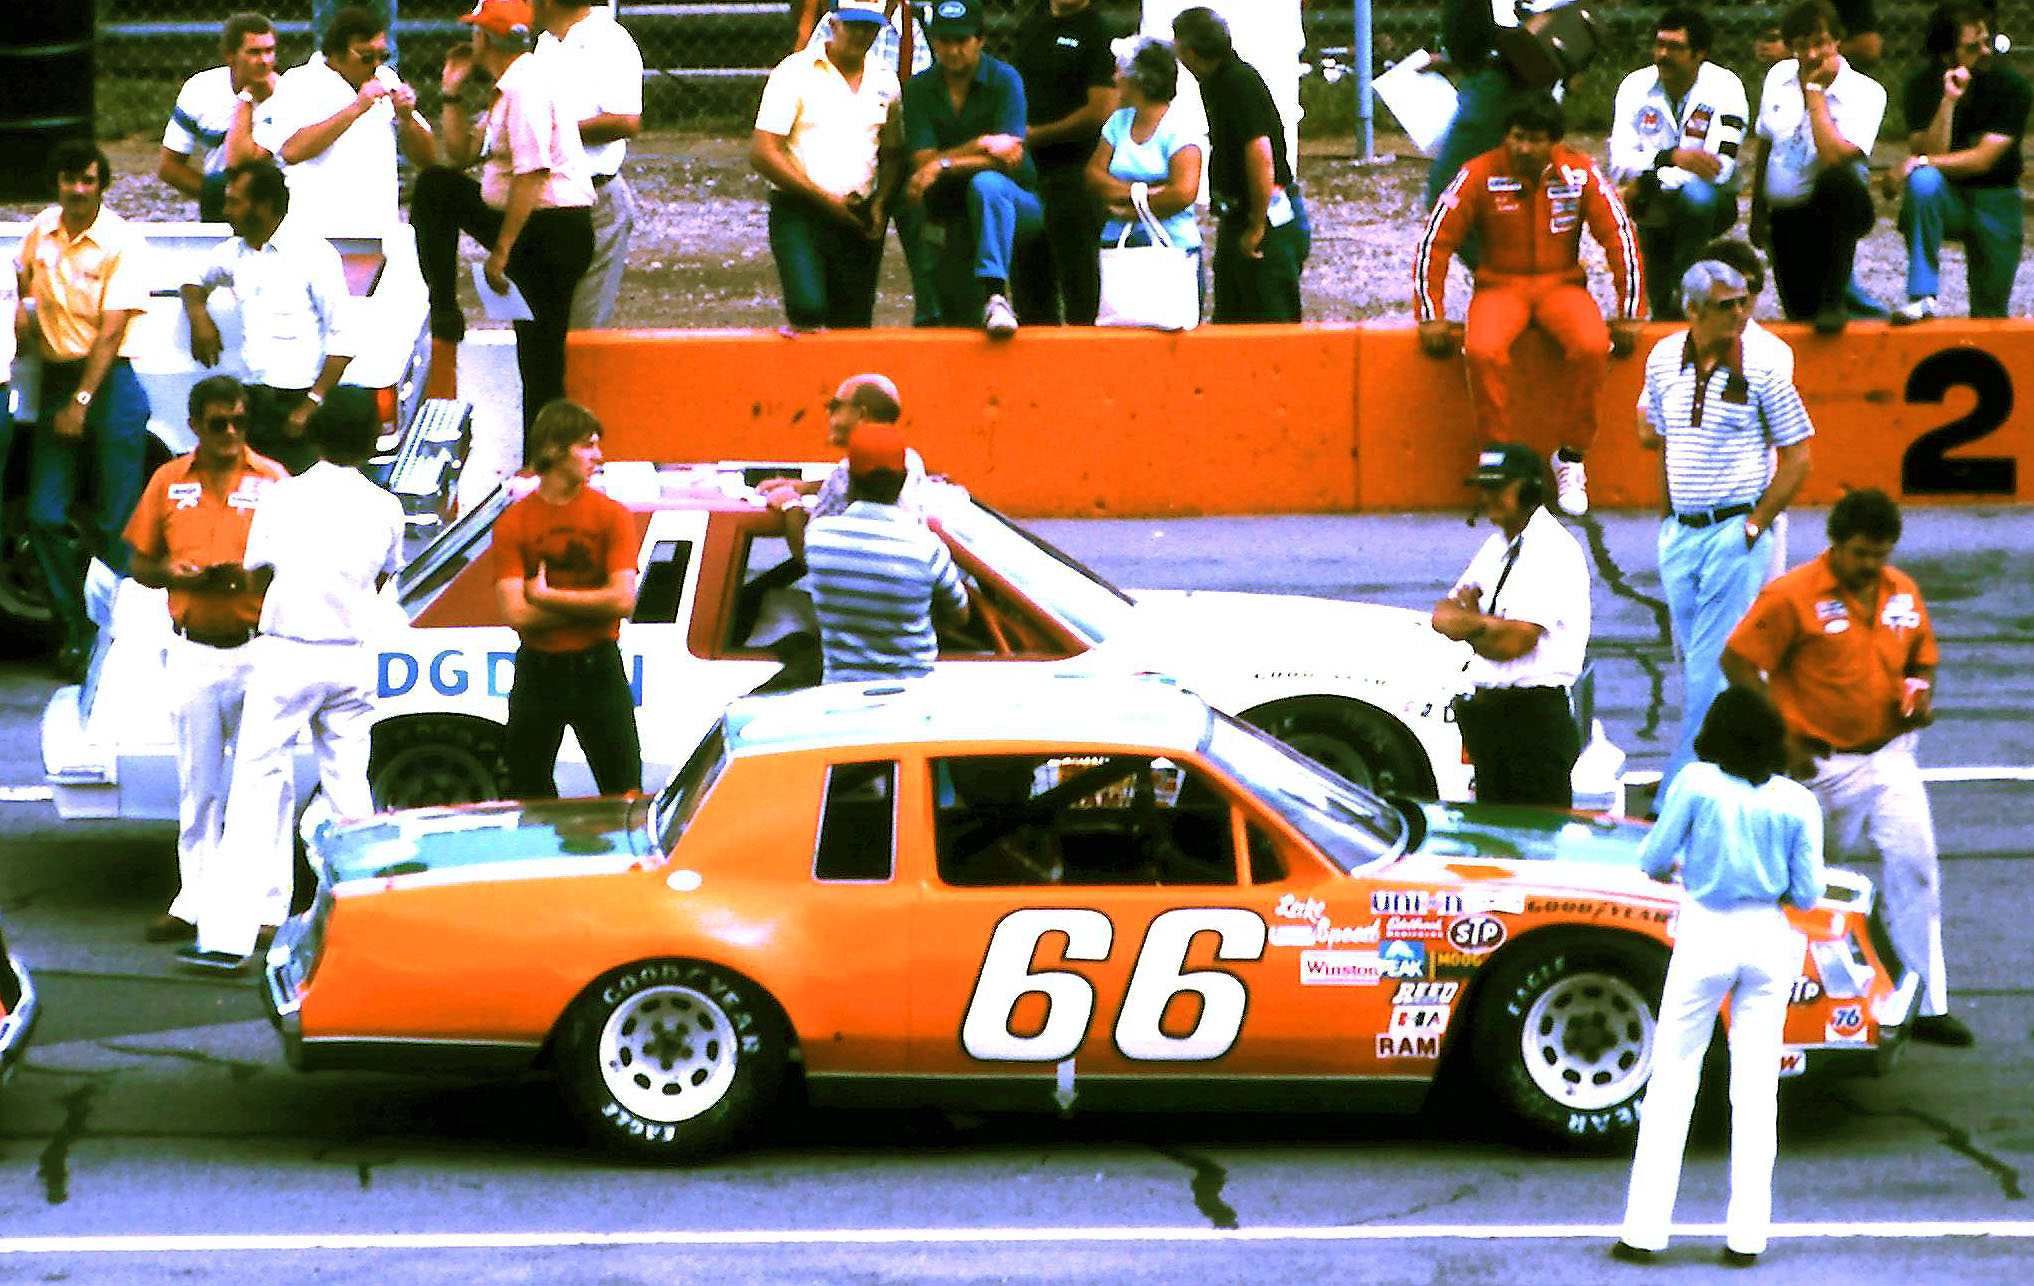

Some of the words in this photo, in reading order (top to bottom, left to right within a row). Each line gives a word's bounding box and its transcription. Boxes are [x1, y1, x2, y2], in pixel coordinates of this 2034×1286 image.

[1903, 347, 2017, 494] 2
[1453, 916, 1501, 947] STP
[1306, 960, 1380, 976] Winston
[960, 906, 1268, 1062] 66
[1392, 982, 1459, 1004] REED
[1790, 976, 1820, 1003] TP
[1834, 1007, 1861, 1028] 76
[1379, 1036, 1437, 1056] RAM
